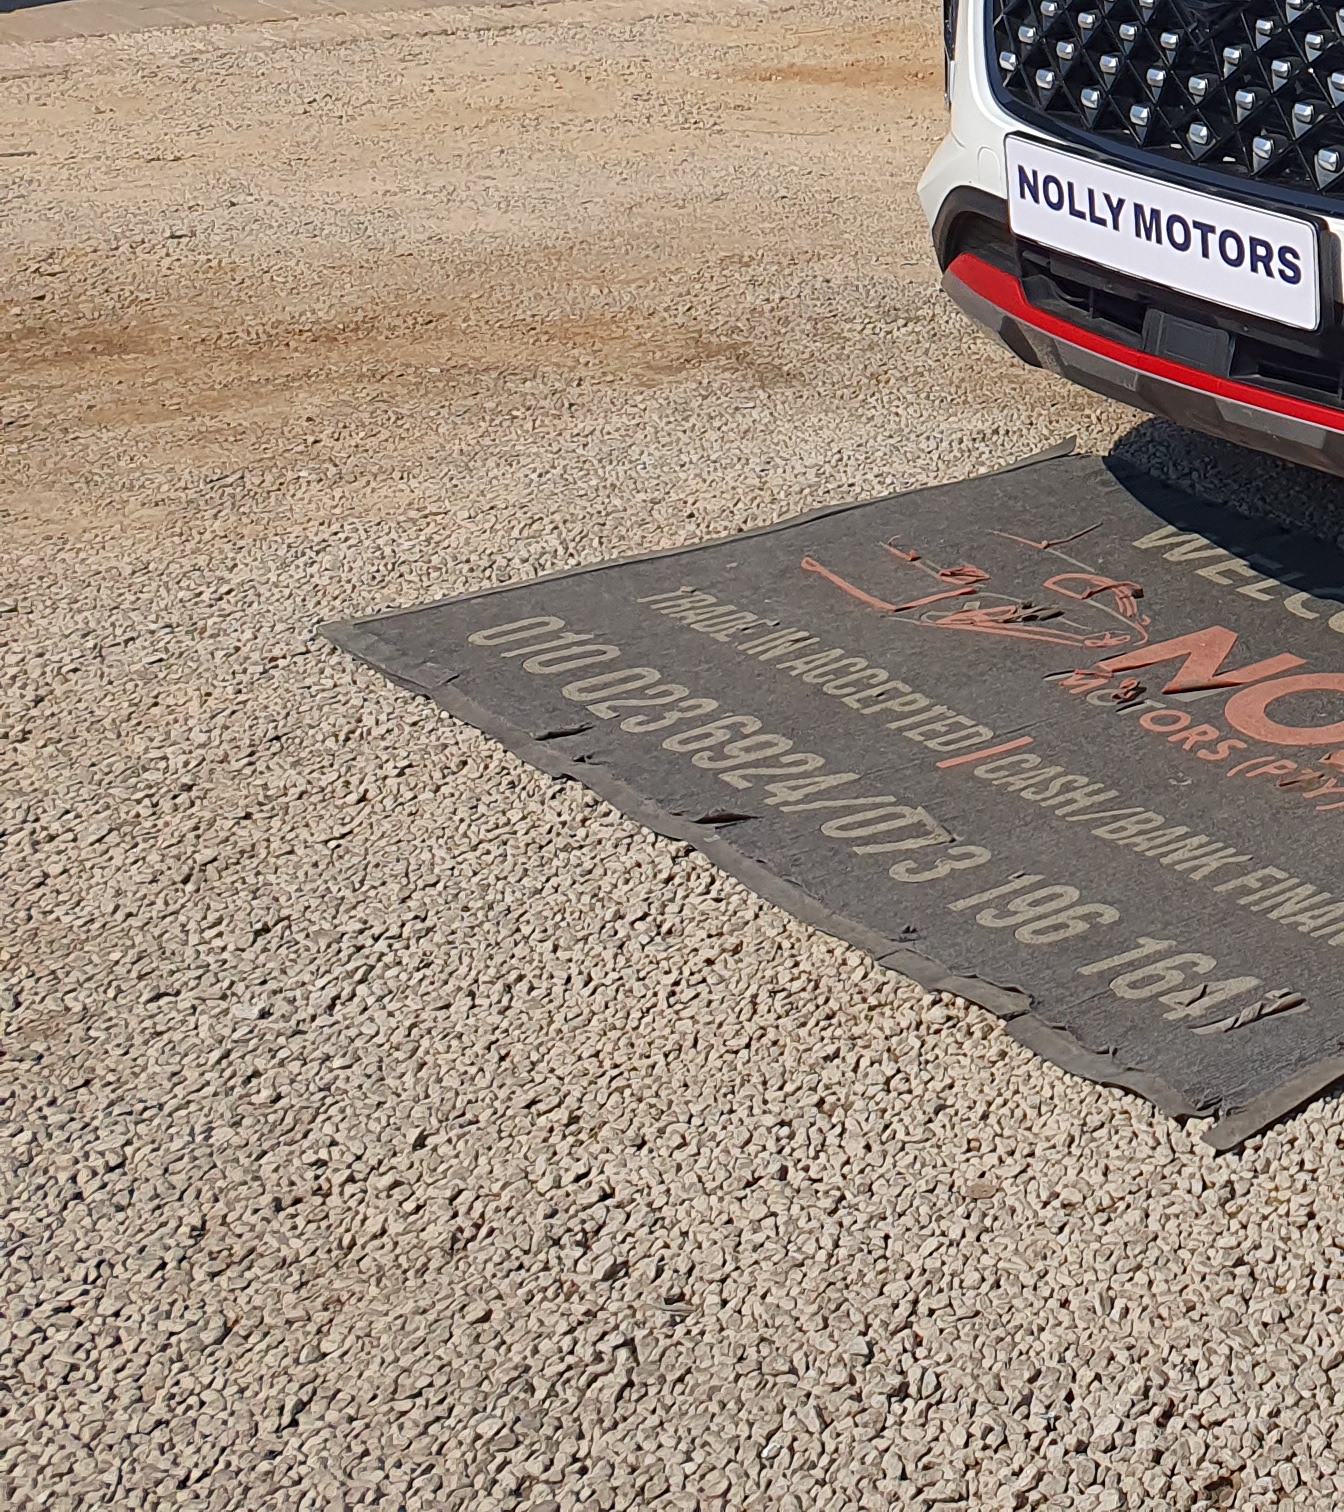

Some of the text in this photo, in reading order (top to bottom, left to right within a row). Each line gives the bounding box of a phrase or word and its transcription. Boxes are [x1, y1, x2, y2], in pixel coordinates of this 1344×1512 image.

[1017, 164, 1302, 285] NOLLY MOTORS
[637, 586, 780, 642] TRADE
[736, 627, 821, 662] IN
[467, 615, 621, 675] 010
[948, 871, 1121, 944] 196
